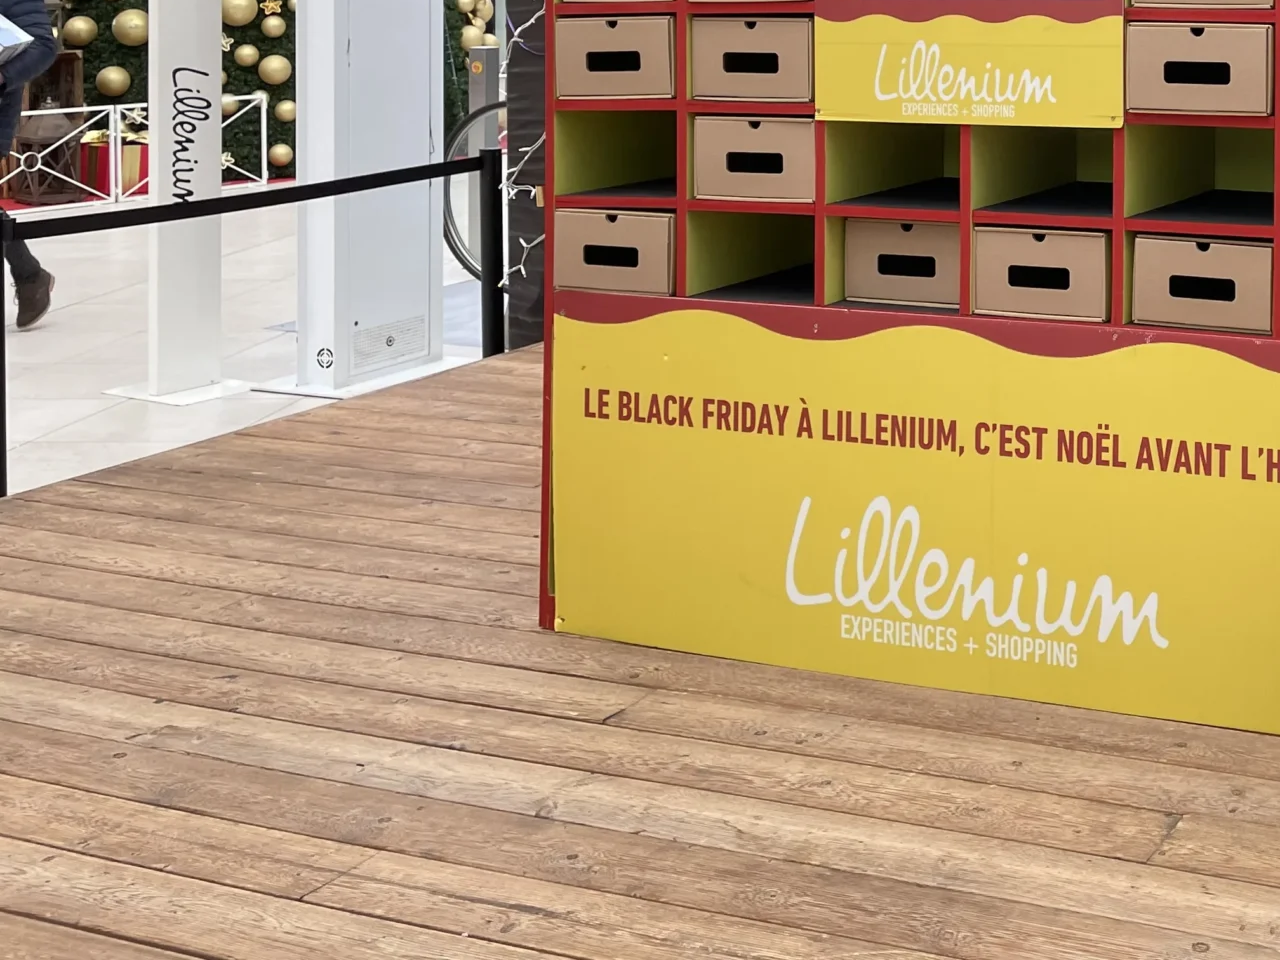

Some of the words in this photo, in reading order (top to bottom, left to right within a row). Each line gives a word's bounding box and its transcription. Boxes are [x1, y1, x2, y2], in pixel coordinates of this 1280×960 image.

[873, 39, 1057, 104] Lillenium
[902, 102, 959, 117] EXPERIENCES
[971, 103, 1015, 118] SHOPPING
[583, 387, 610, 419] LE
[617, 390, 694, 428] BLACK
[702, 397, 789, 437] FRIDAY
[796, 397, 814, 439] À
[822, 408, 965, 458] LILLENIUM,
[975, 421, 1048, 460] C'EST
[1057, 423, 1127, 468] NOËL
[1135, 436, 1231, 478] AVANT
[785, 495, 1169, 649] Lillenium
[840, 613, 957, 653] EXPERIENCES
[963, 637, 979, 655] +
[985, 632, 1078, 669] SHOPPING
